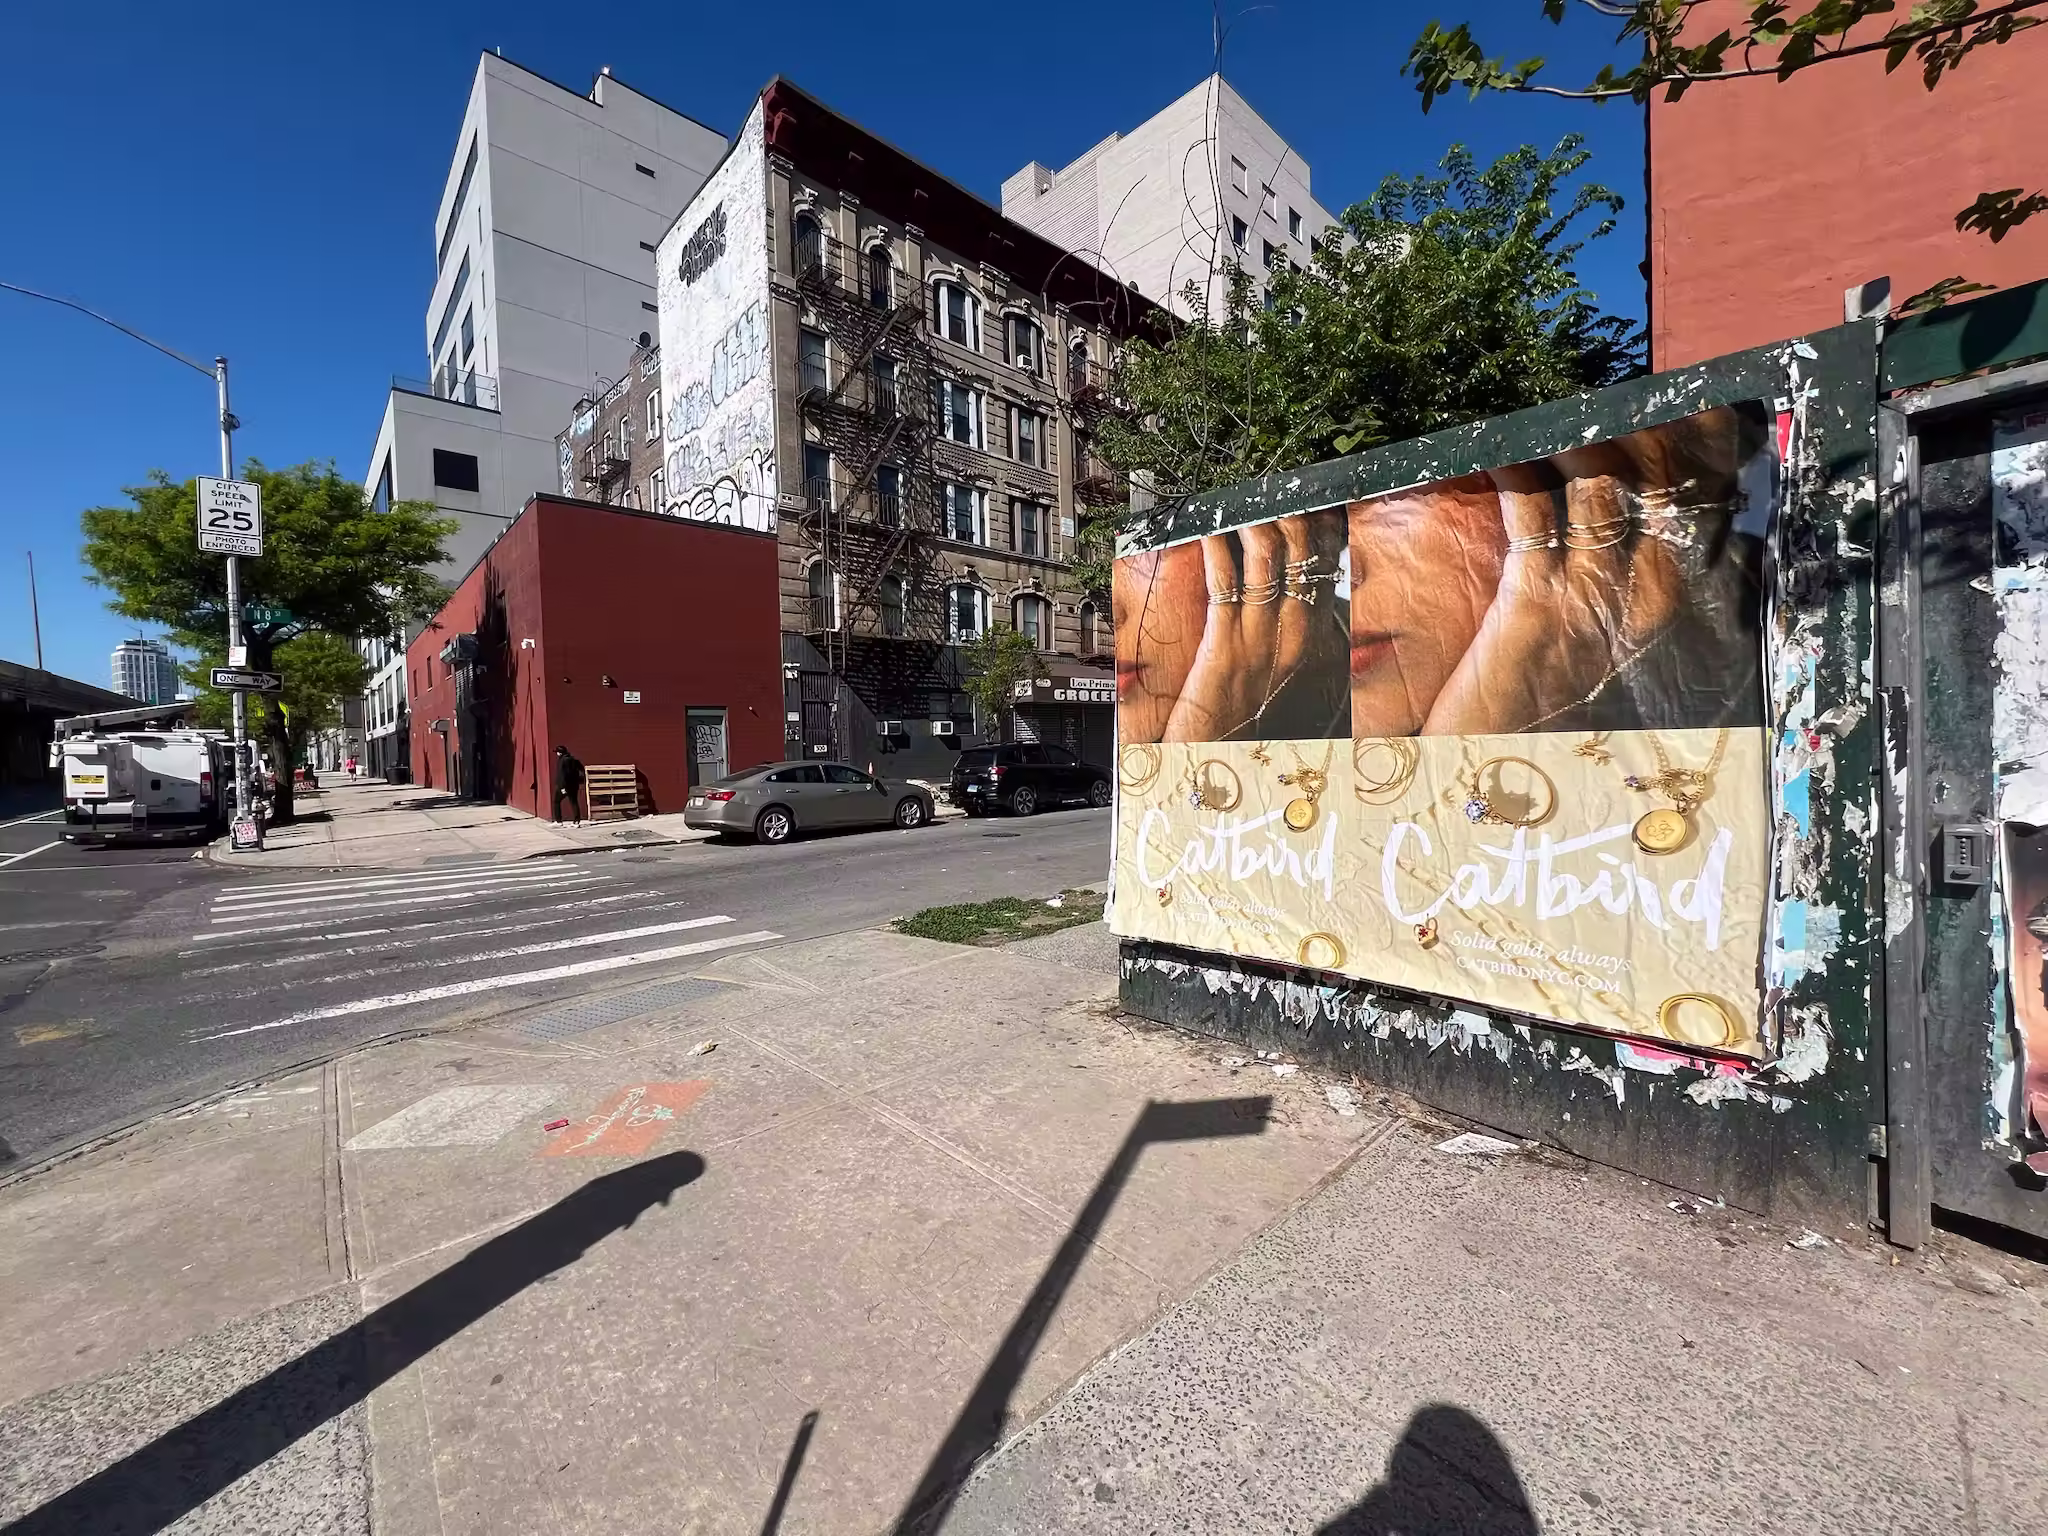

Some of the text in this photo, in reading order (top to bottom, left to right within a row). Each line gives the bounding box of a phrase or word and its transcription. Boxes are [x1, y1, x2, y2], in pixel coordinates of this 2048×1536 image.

[216, 483, 240, 491] CITY
[211, 490, 246, 500] SPEED
[215, 499, 243, 508] LIMIT
[208, 508, 253, 531] 25
[215, 536, 246, 545] PHOTO
[206, 541, 256, 552] ENFORCED
[253, 609, 260, 620] N
[265, 610, 271, 620] 8
[220, 675, 271, 685] ONE WAY
[1072, 679, 1087, 687] Los
[1136, 808, 1338, 902] Catbird
[1381, 822, 1734, 952] Catbird
[1450, 930, 1632, 975] Solid gold, always
[1456, 956, 1621, 993] CATBIRDNYC.COM
